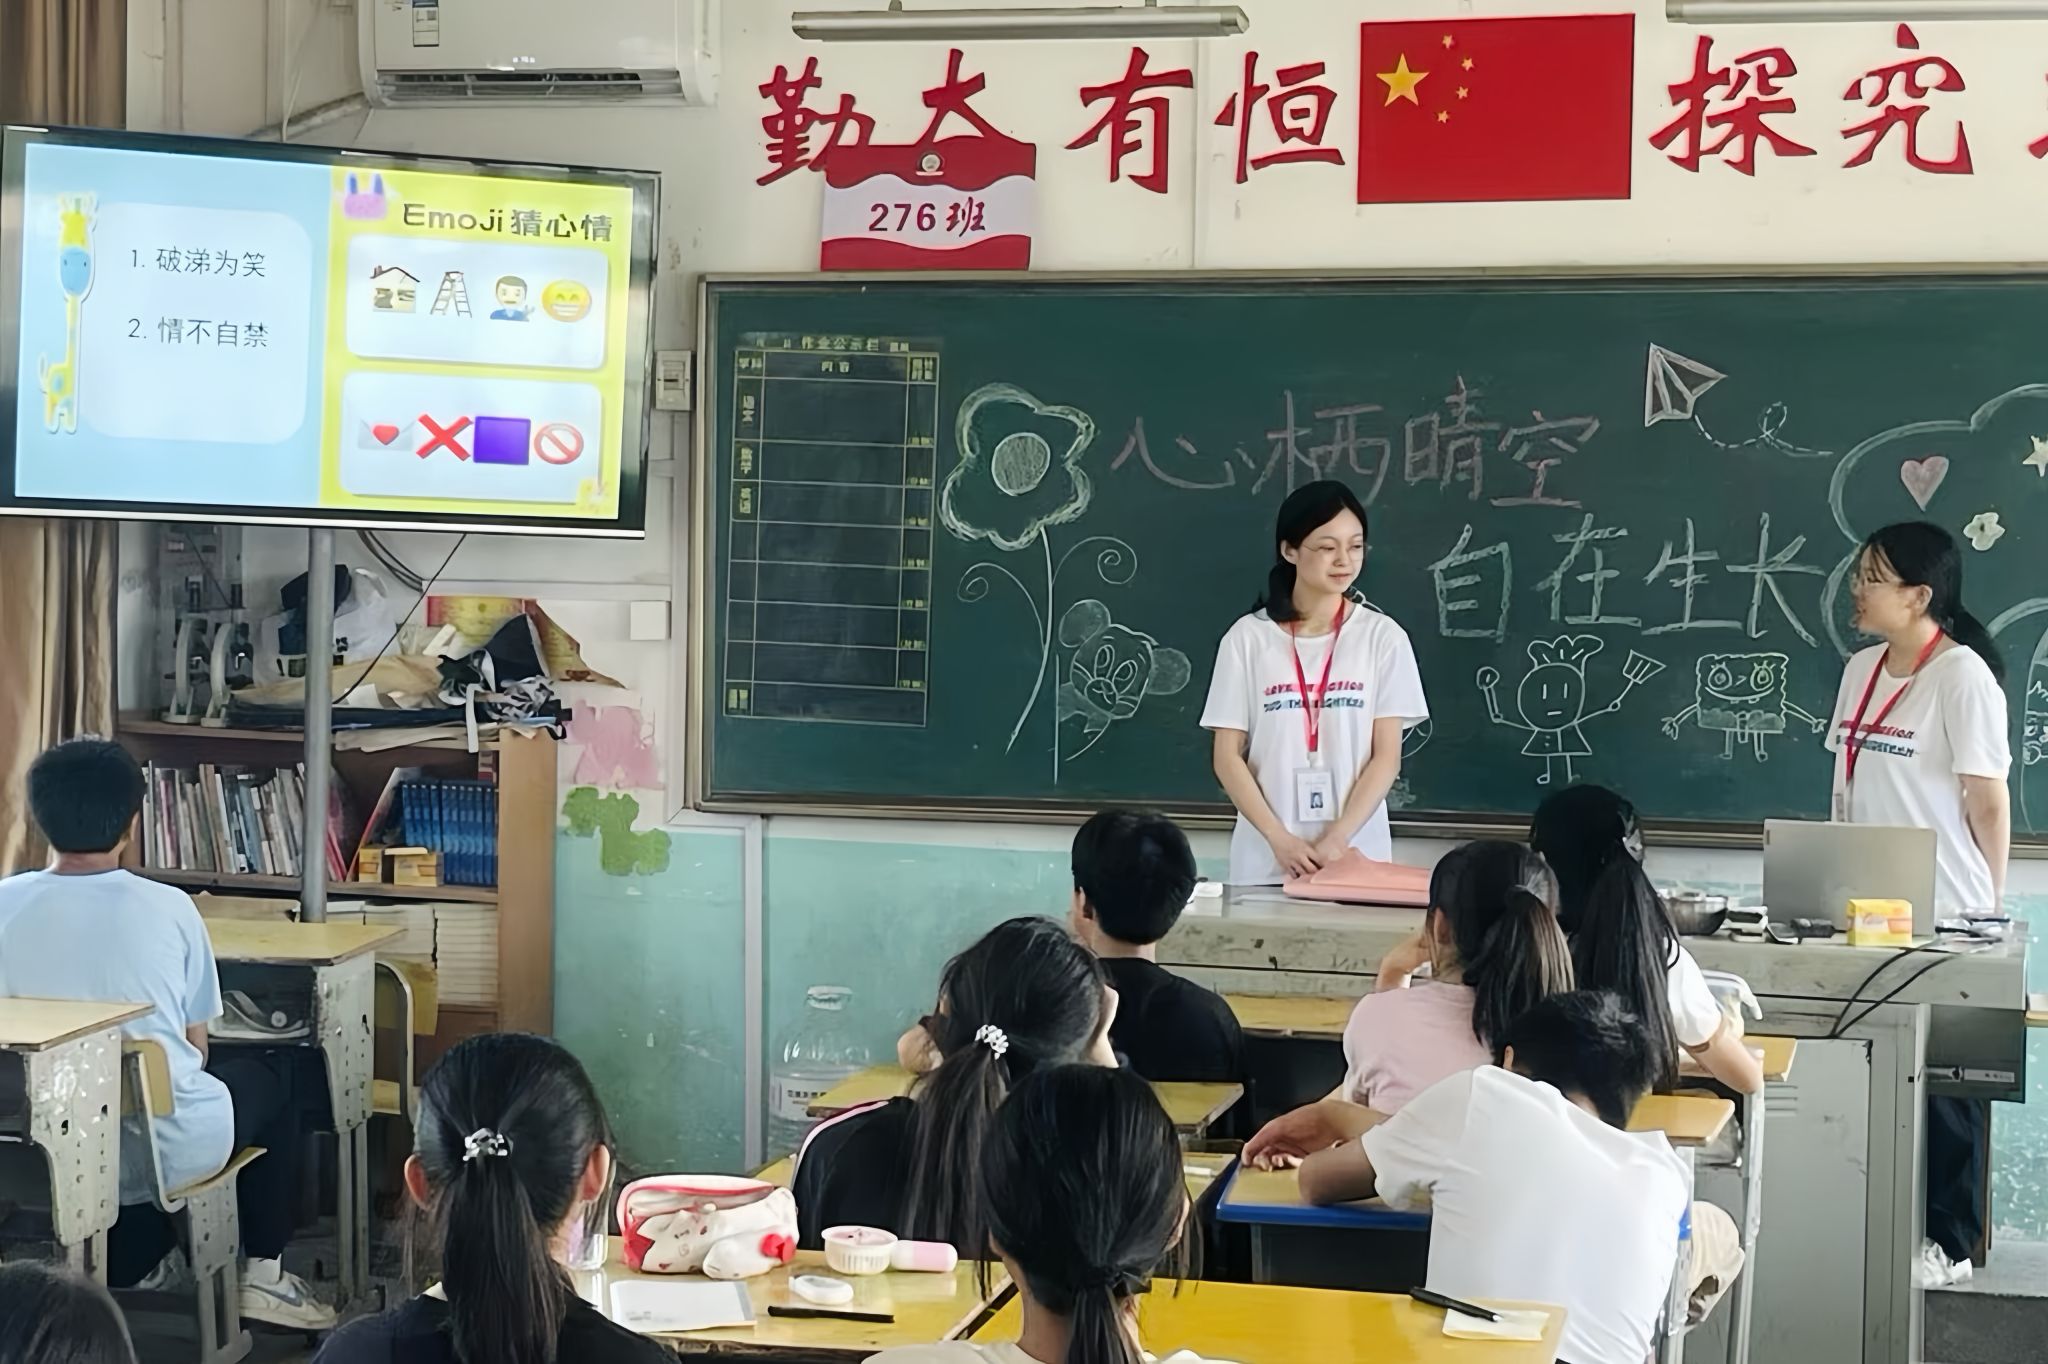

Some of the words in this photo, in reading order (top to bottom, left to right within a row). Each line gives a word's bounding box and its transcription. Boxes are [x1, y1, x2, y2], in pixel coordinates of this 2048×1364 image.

[1648, 22, 2048, 177] 探究
[156, 245, 266, 278] 破涕为笑
[403, 203, 503, 232] Emoji
[510, 208, 613, 242] 猜心情
[157, 315, 269, 348] 情不自禁
[1110, 375, 1601, 509] 心栖晴空
[1426, 511, 1826, 648] 自在生长
